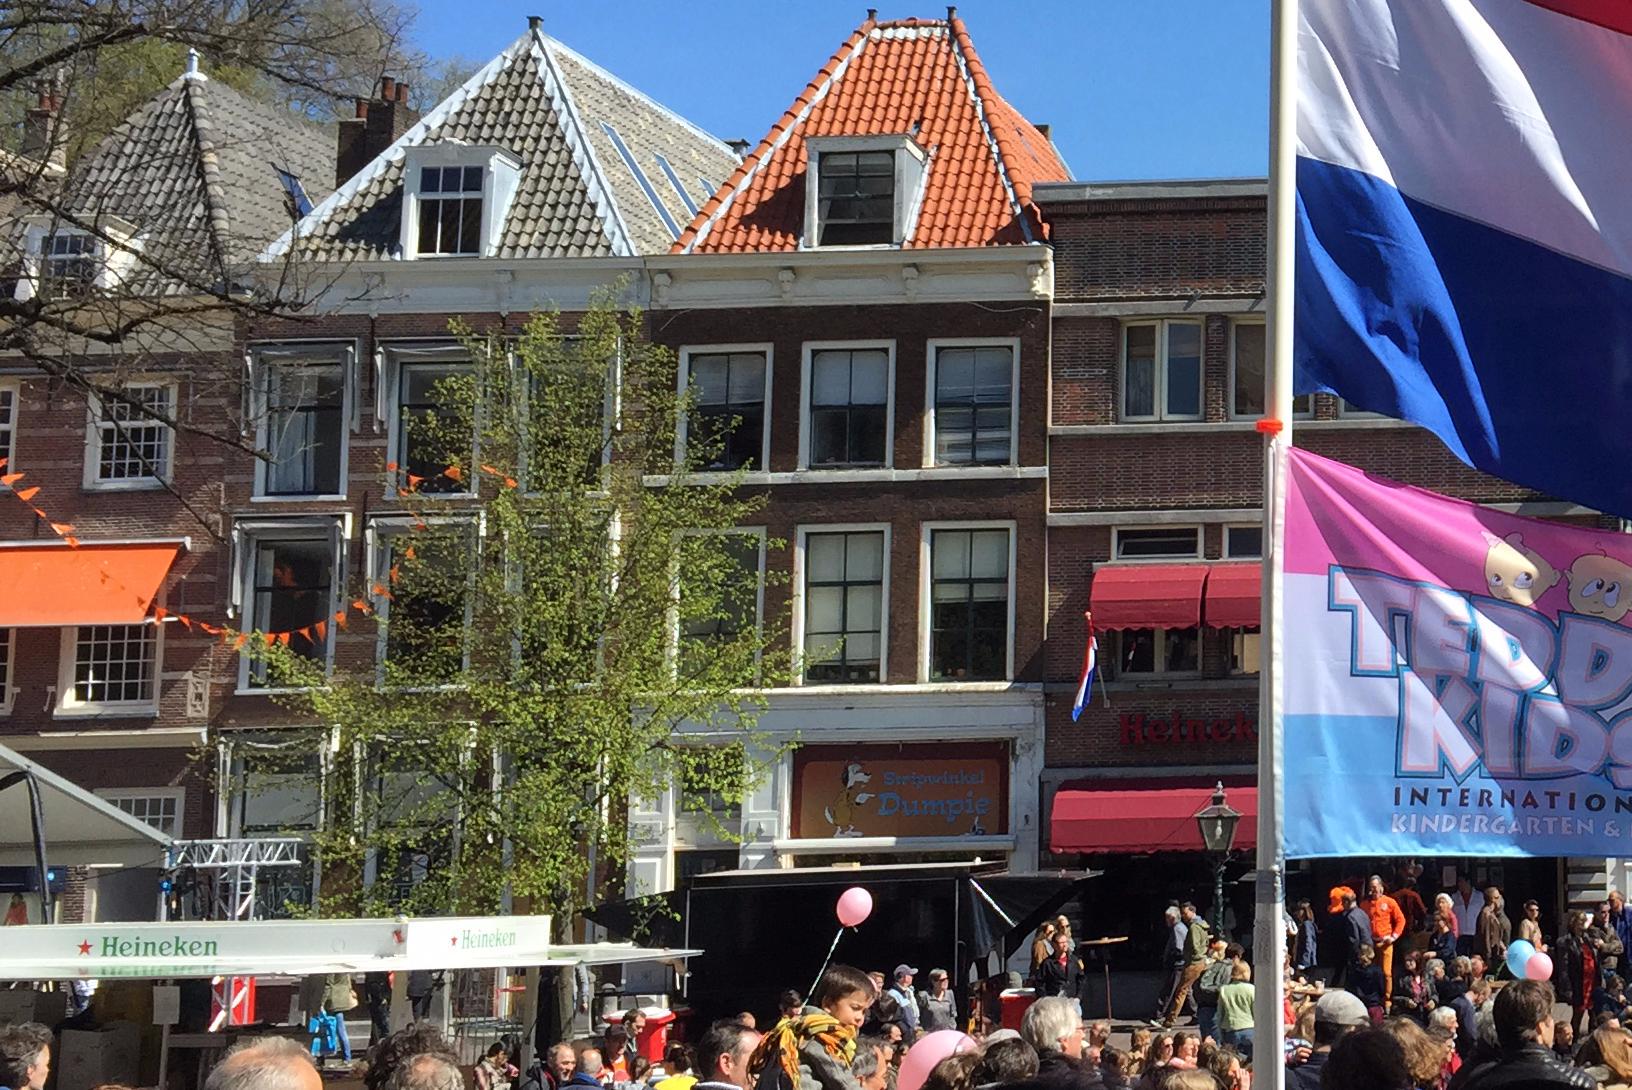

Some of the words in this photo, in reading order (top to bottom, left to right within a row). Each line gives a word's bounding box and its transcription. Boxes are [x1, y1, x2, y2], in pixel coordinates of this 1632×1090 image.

[1119, 710, 1259, 745] Heinek
[878, 788, 993, 824] Dumpie
[1391, 812, 1595, 837] KINDERGARTEN
[1603, 820, 1621, 838] &
[100, 936, 217, 957] Heineken
[462, 928, 517, 949] Heineken
